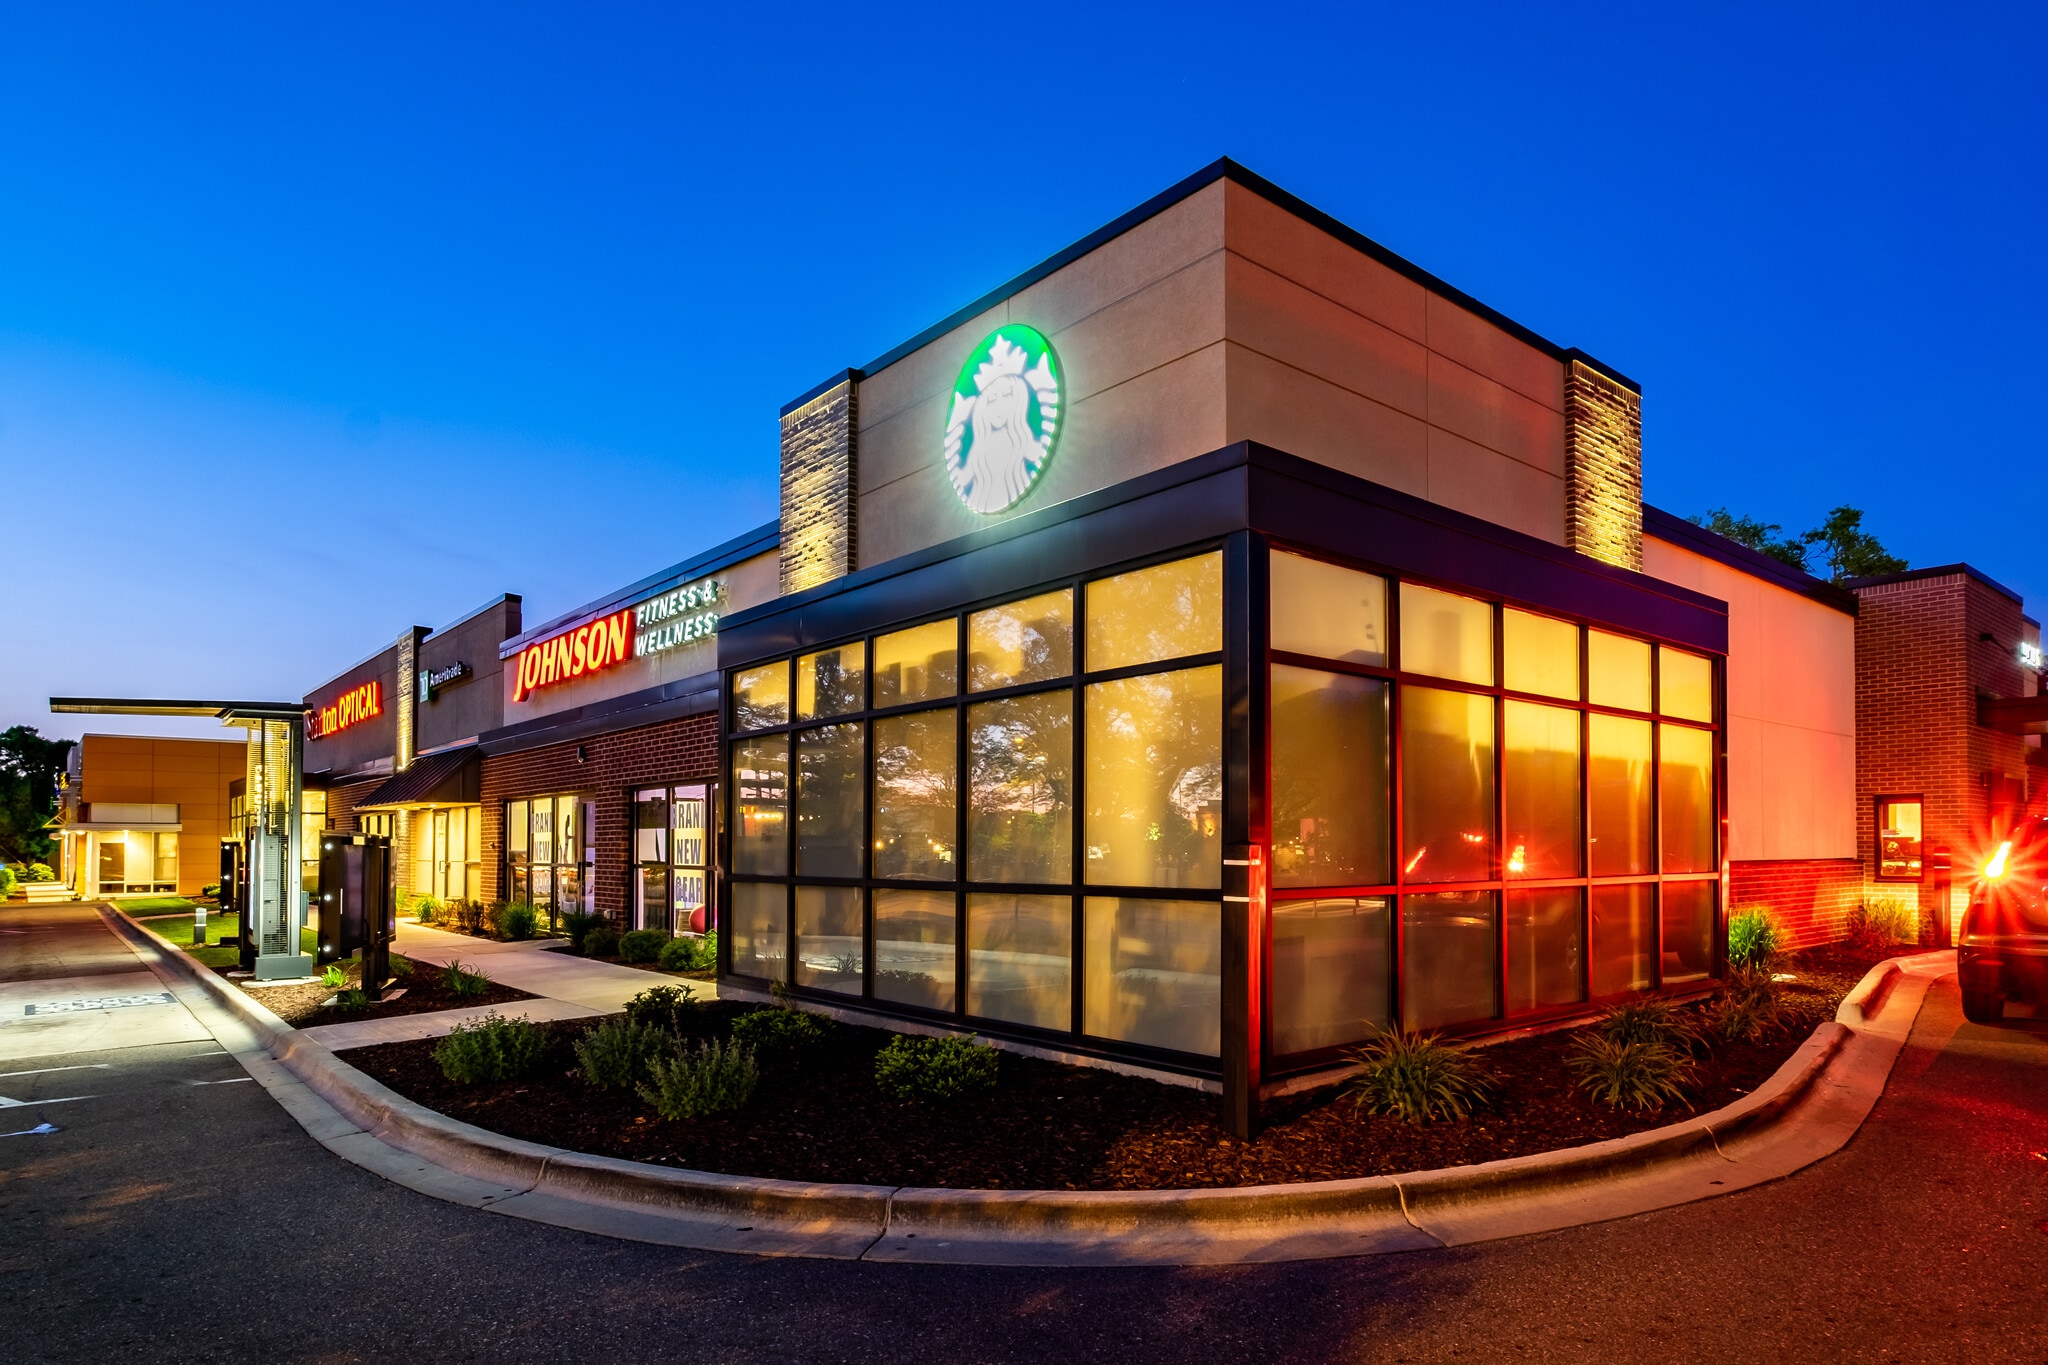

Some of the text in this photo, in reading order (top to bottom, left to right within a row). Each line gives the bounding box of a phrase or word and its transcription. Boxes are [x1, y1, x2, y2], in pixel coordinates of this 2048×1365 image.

[636, 579, 717, 628] FITNESS &
[513, 610, 629, 702] JOHNSON
[636, 611, 718, 656] WELLNESS
[339, 681, 379, 729] OPTICAL
[534, 841, 550, 861] NEW
[676, 838, 702, 865] NEW
